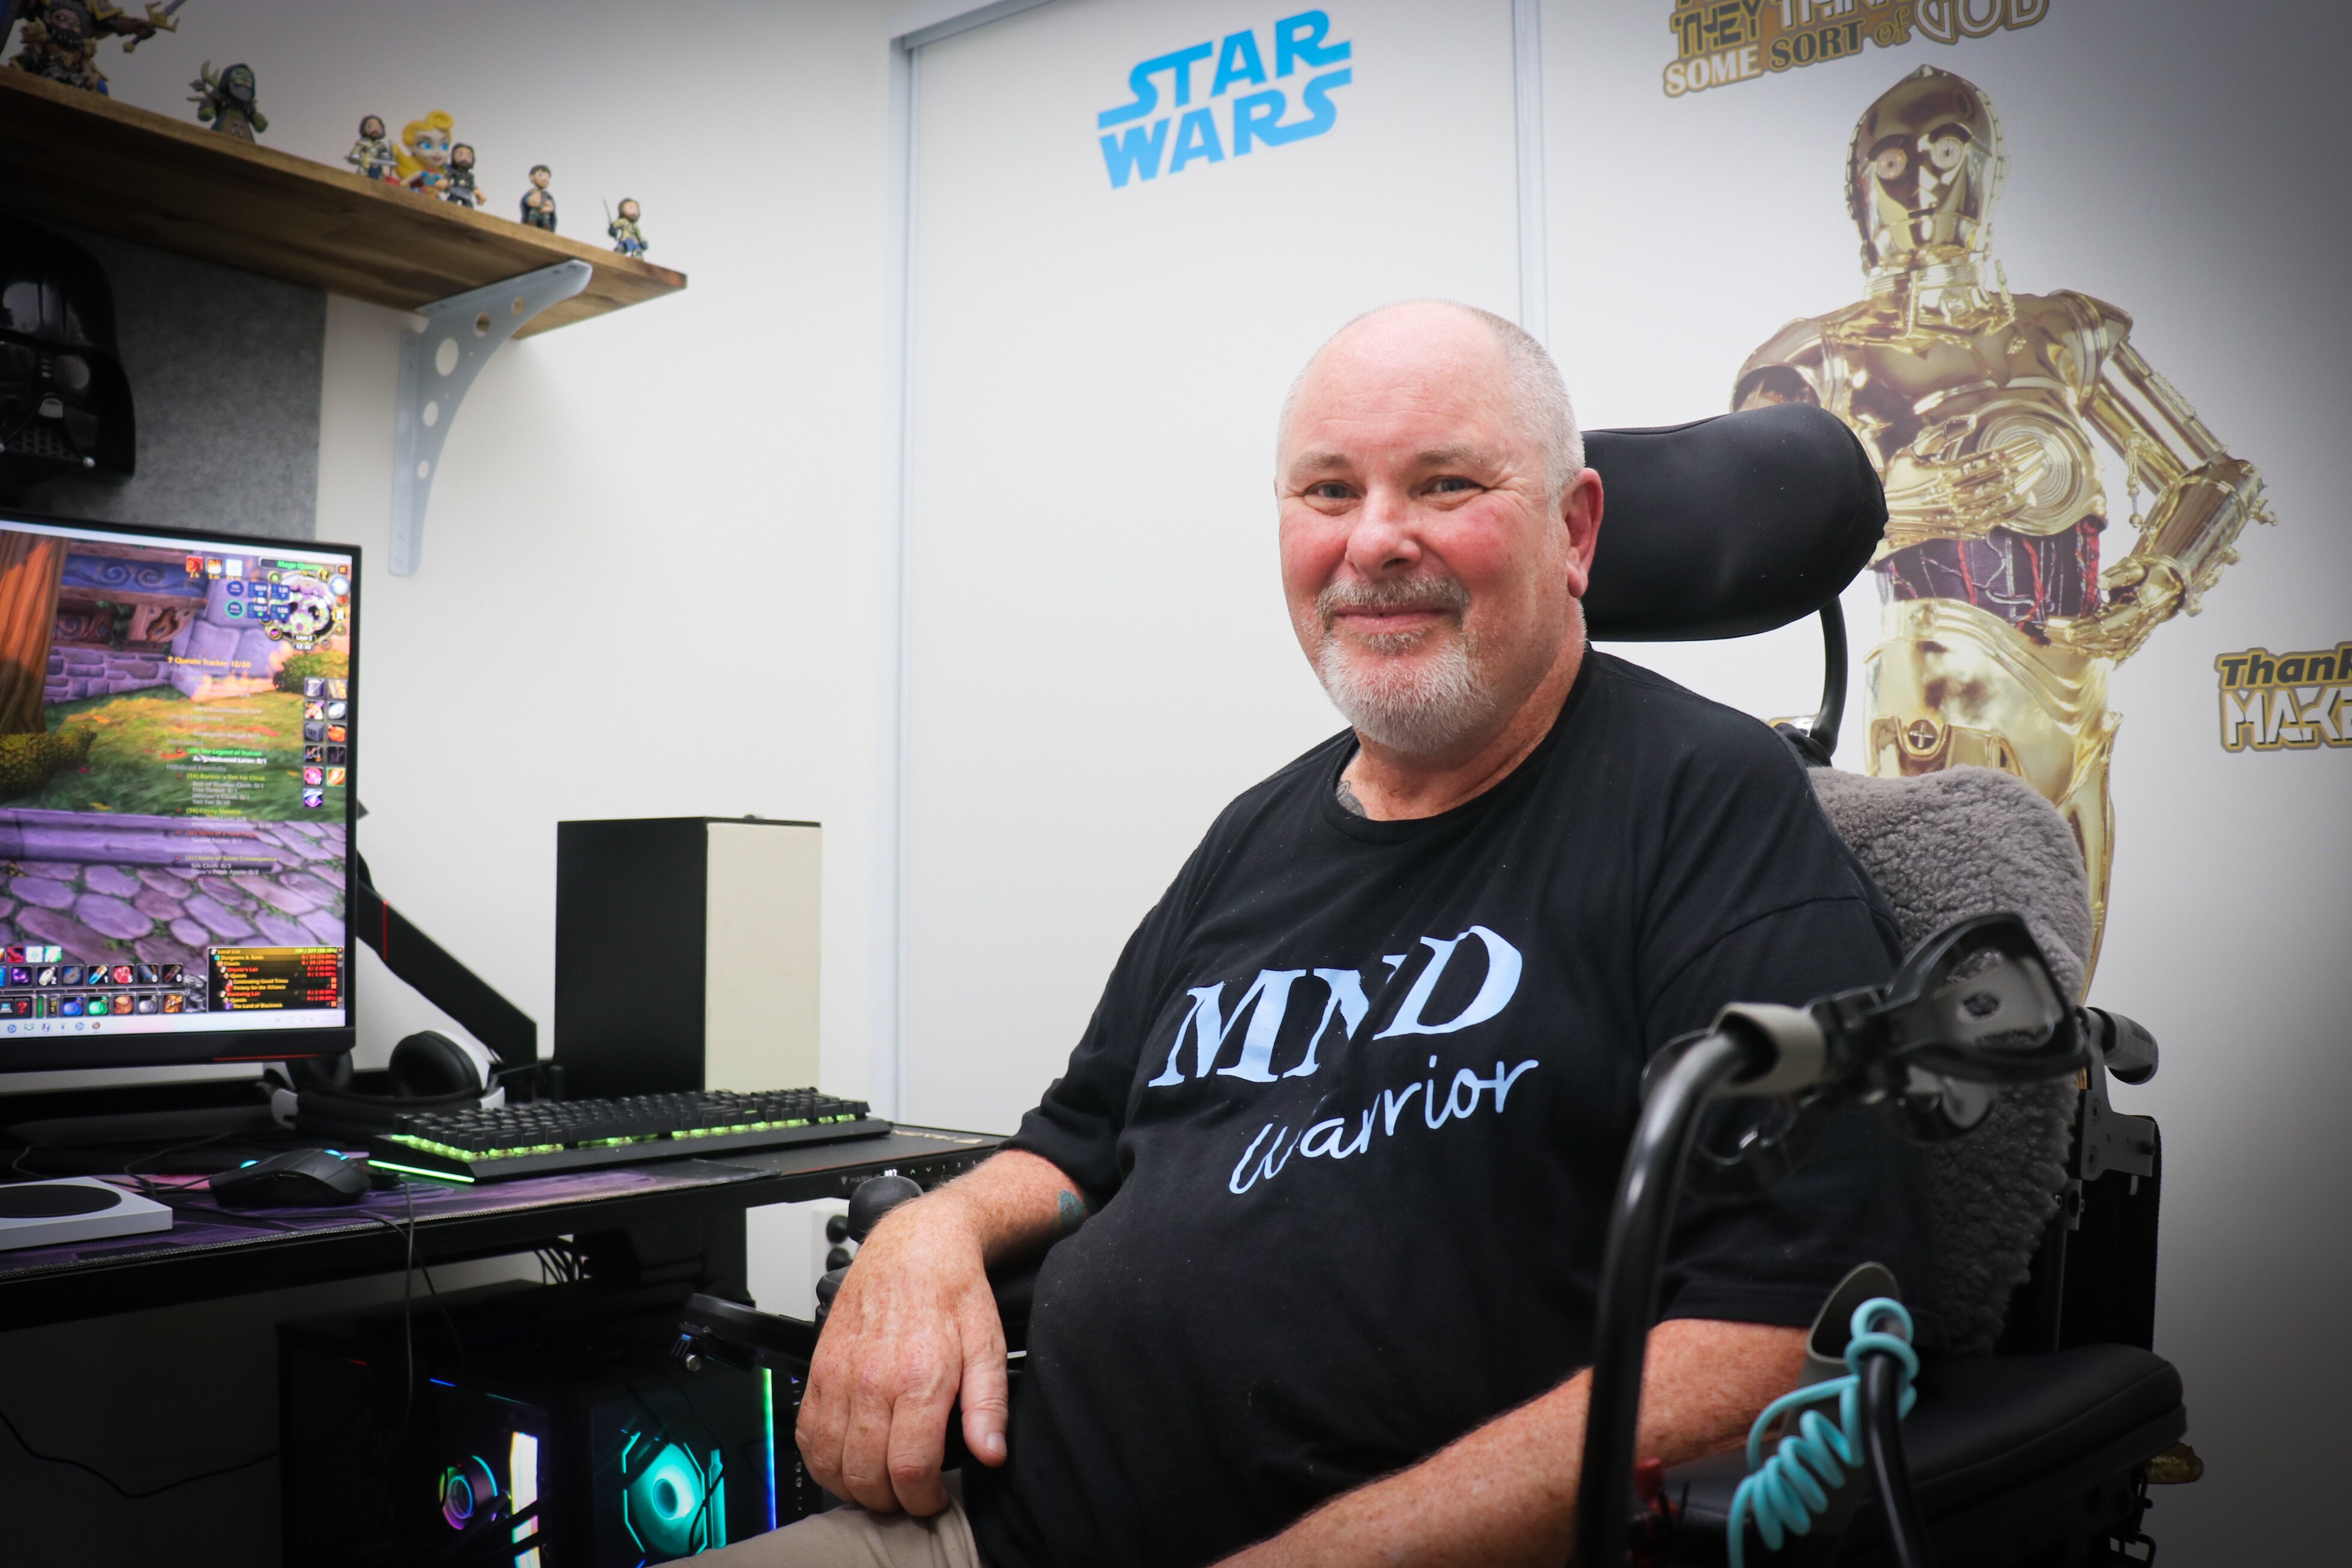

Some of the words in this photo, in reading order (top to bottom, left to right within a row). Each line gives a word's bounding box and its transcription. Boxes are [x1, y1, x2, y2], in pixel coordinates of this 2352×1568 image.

[1098, 10, 1351, 130] STAR
[1666, 46, 1760, 94] SOME
[1771, 20, 1864, 68] SORT
[1875, 6, 1910, 44] of
[1099, 67, 1352, 189] WARS
[1148, 925, 1523, 1087] MND
